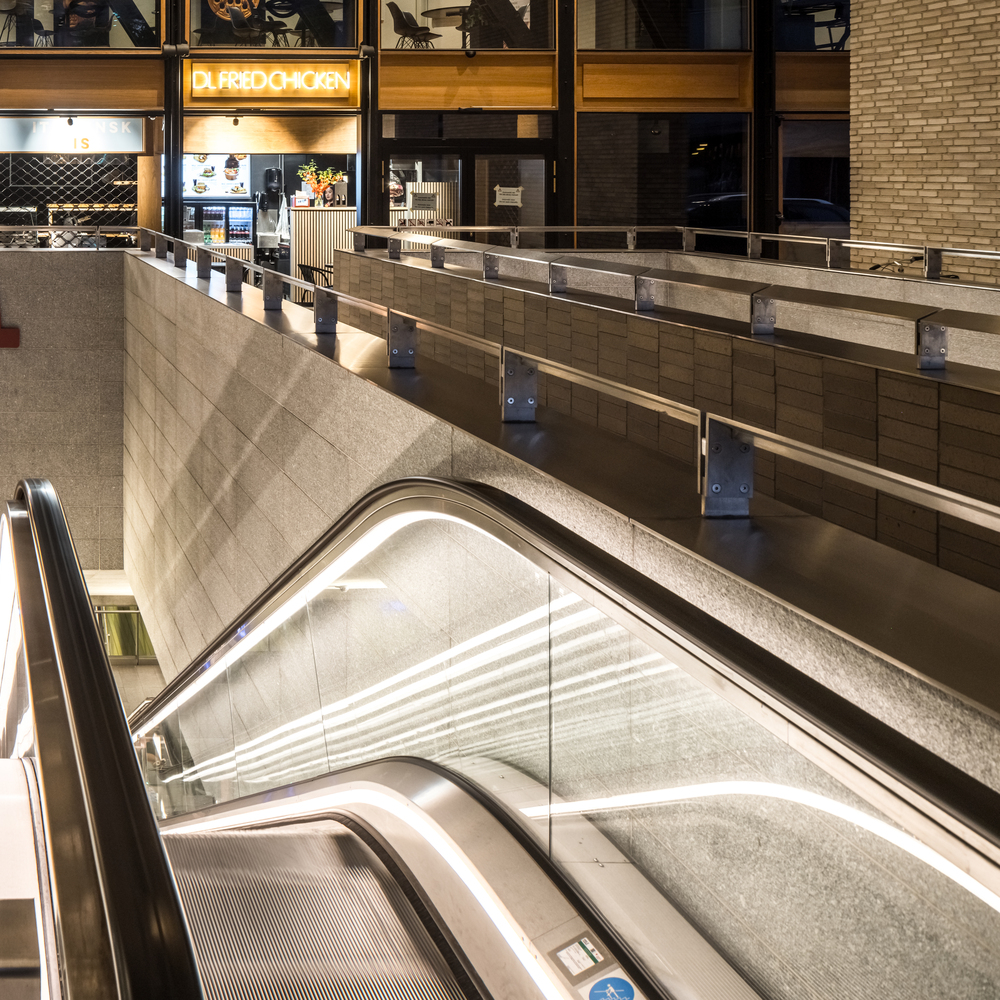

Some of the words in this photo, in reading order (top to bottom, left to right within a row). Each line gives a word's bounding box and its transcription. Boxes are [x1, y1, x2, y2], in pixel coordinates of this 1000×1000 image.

[192, 71, 217, 89] DL
[219, 71, 267, 90] FRIED
[269, 71, 350, 90] CHICKEN
[73, 138, 90, 149] IS
